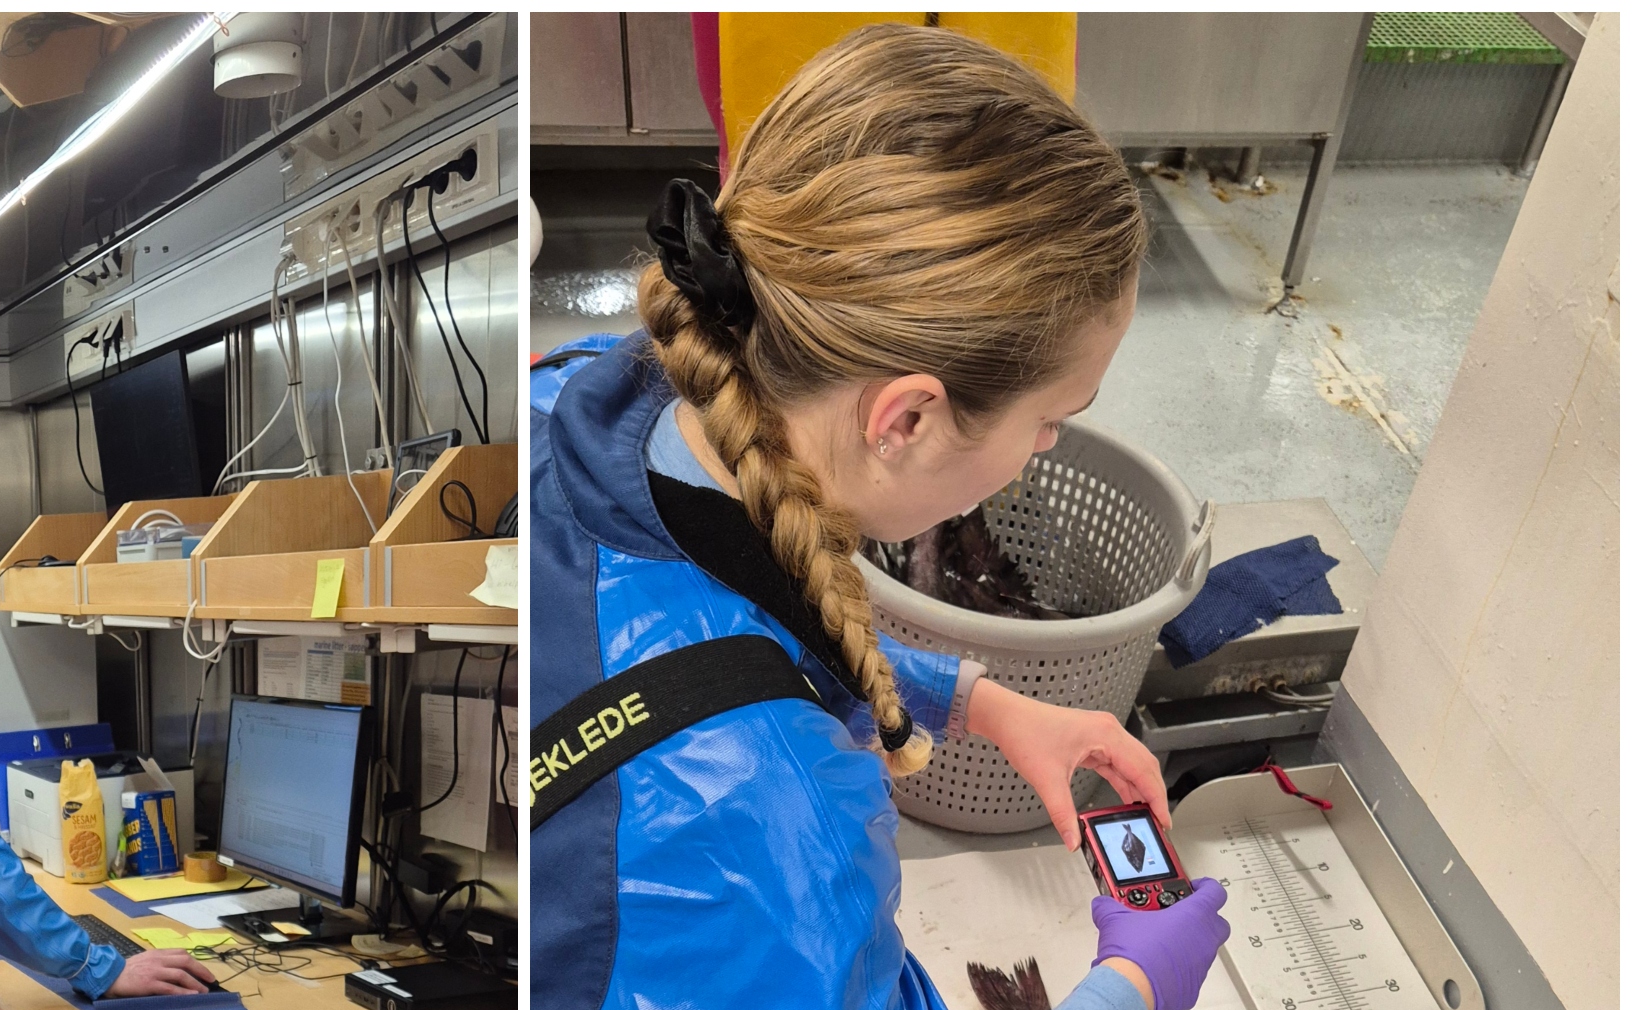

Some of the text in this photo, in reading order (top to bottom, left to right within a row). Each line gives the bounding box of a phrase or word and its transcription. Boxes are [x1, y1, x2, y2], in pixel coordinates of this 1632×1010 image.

[72, 814, 97, 825] SESAM
[1248, 935, 1263, 948] 20
[1282, 998, 1297, 1010] 30
[1385, 979, 1400, 992] 30
